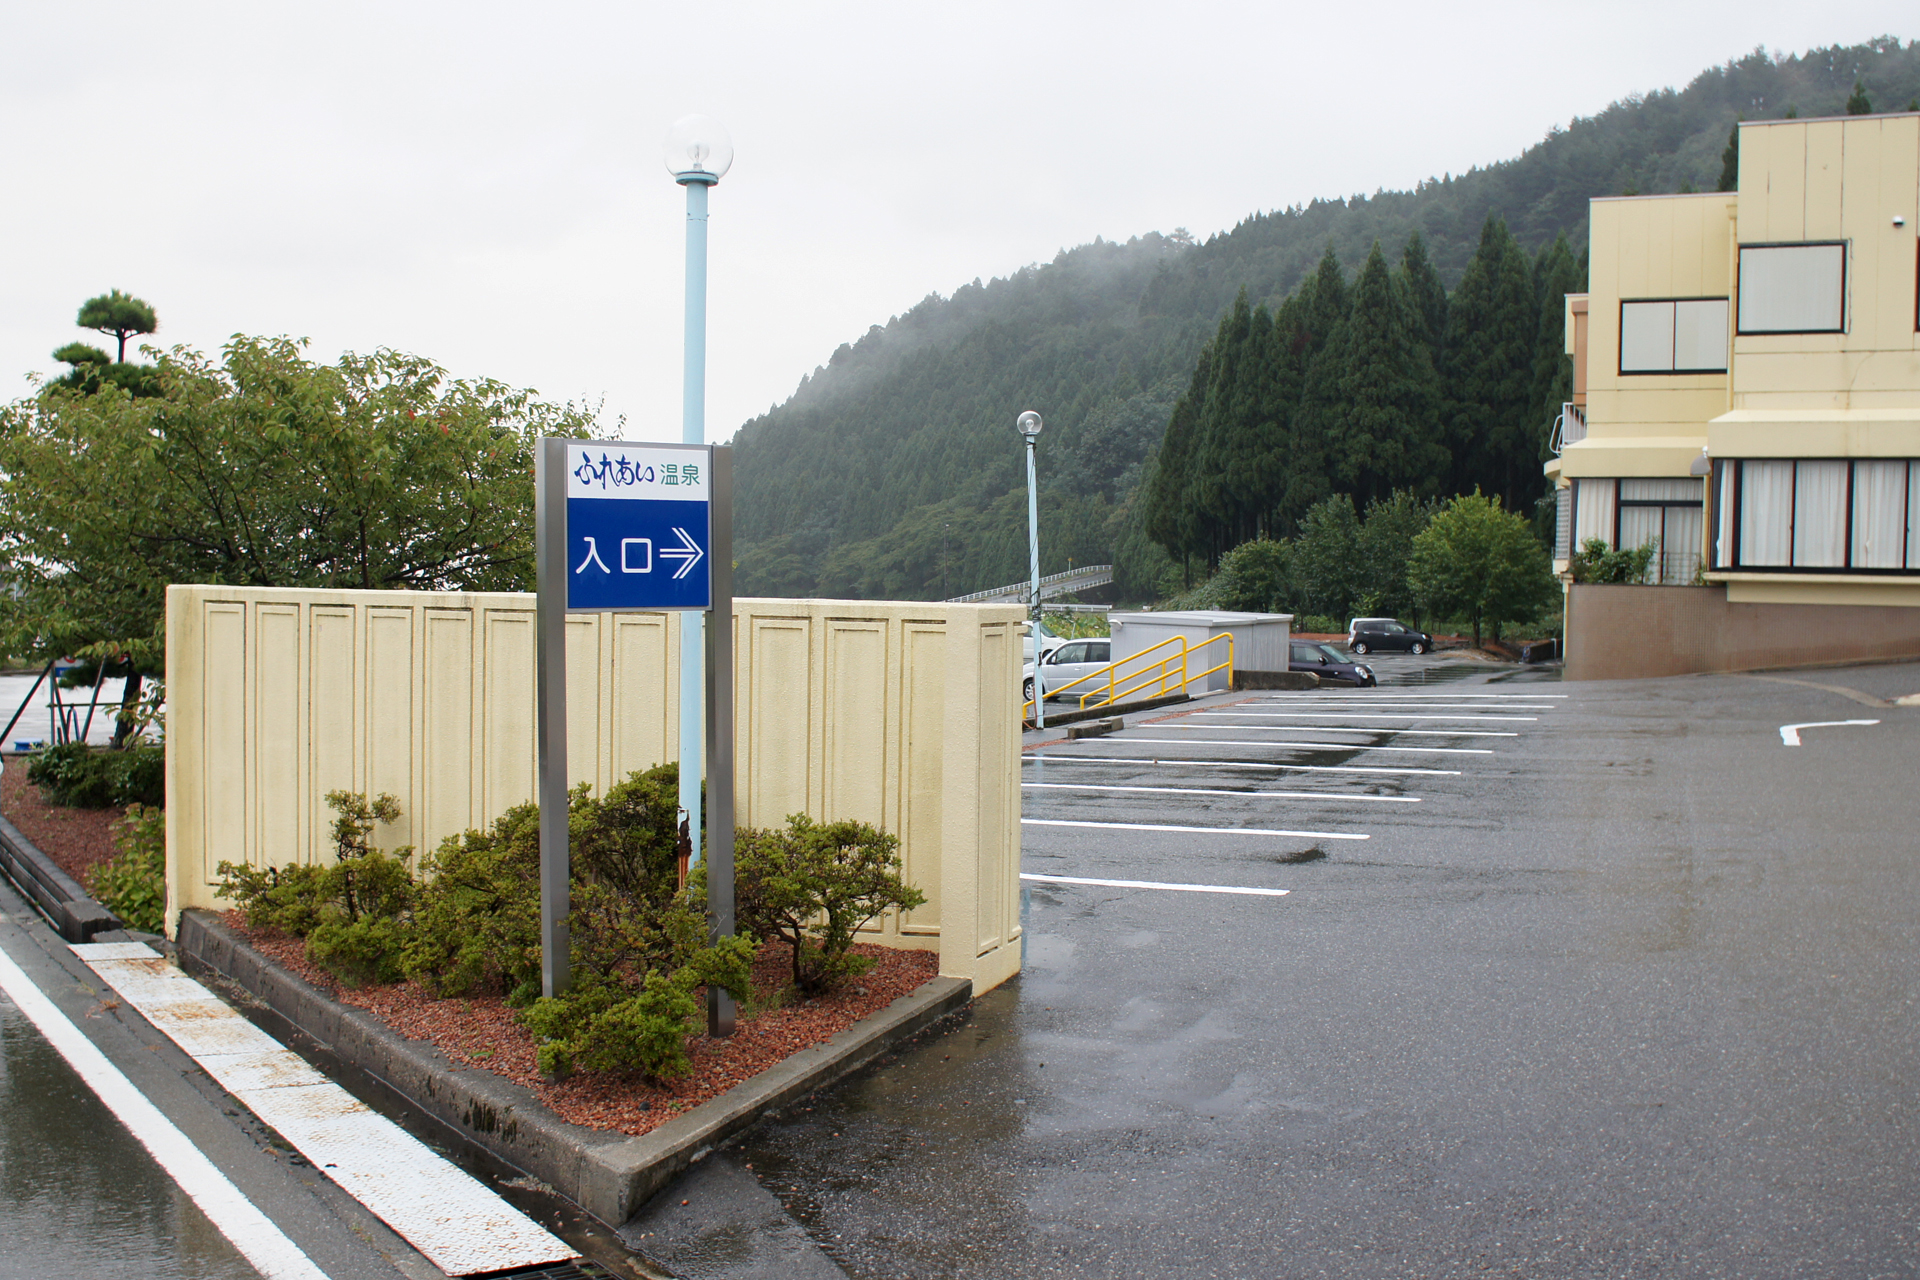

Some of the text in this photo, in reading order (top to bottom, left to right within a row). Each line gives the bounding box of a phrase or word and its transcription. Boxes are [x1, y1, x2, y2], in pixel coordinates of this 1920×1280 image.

[574, 451, 701, 490] ふれあい 温泉
[575, 536, 653, 575] 入口
